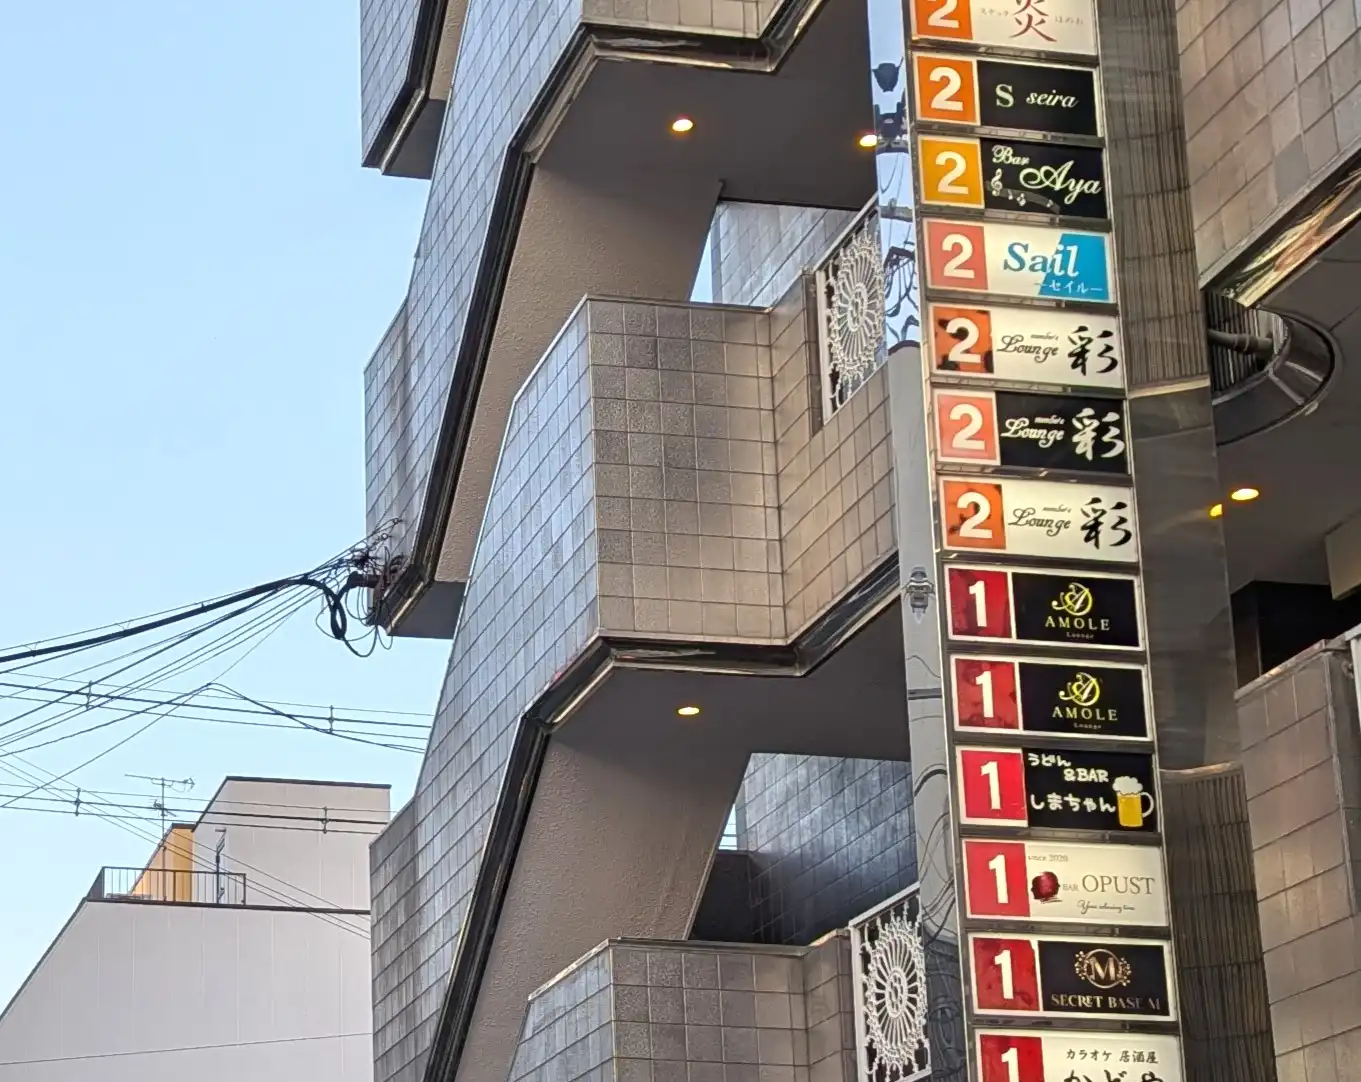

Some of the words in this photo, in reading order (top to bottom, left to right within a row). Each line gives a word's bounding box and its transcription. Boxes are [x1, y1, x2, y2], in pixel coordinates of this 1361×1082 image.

[927, 0, 960, 29] 2
[929, 66, 964, 111] 2
[995, 84, 1015, 107] S
[1026, 89, 1079, 108] seira
[935, 151, 969, 195] 2
[991, 144, 1030, 166] Bar
[1019, 160, 1101, 205] Aya
[942, 233, 975, 279] 2
[1003, 242, 1080, 277] Sail
[946, 317, 981, 363] 2
[997, 334, 1059, 363] Lounge
[1067, 325, 1118, 376] 彩
[949, 403, 986, 450] 2
[1001, 418, 1065, 448] Lounge
[1071, 407, 1125, 461] 彩
[957, 491, 993, 539] 2
[1008, 507, 1071, 537] Lounge
[1080, 497, 1133, 550] 彩
[968, 580, 987, 627] 1
[1045, 616, 1110, 631] AMOLE
[975, 670, 994, 718] 1
[1052, 706, 1118, 721] AMOLE
[1028, 753, 1072, 768] うどん
[1063, 769, 1109, 783] &BAR
[980, 761, 1001, 810] 1
[1031, 793, 1116, 813] しまちゃん
[988, 854, 1009, 904] 1
[1082, 874, 1155, 895] OPUST
[994, 949, 1014, 999] 1
[1051, 993, 1103, 1008] SECRET
[1108, 996, 1143, 1009] BASE
[1066, 1049, 1113, 1062] カラオケ
[1119, 1050, 1159, 1064] 居酒屋
